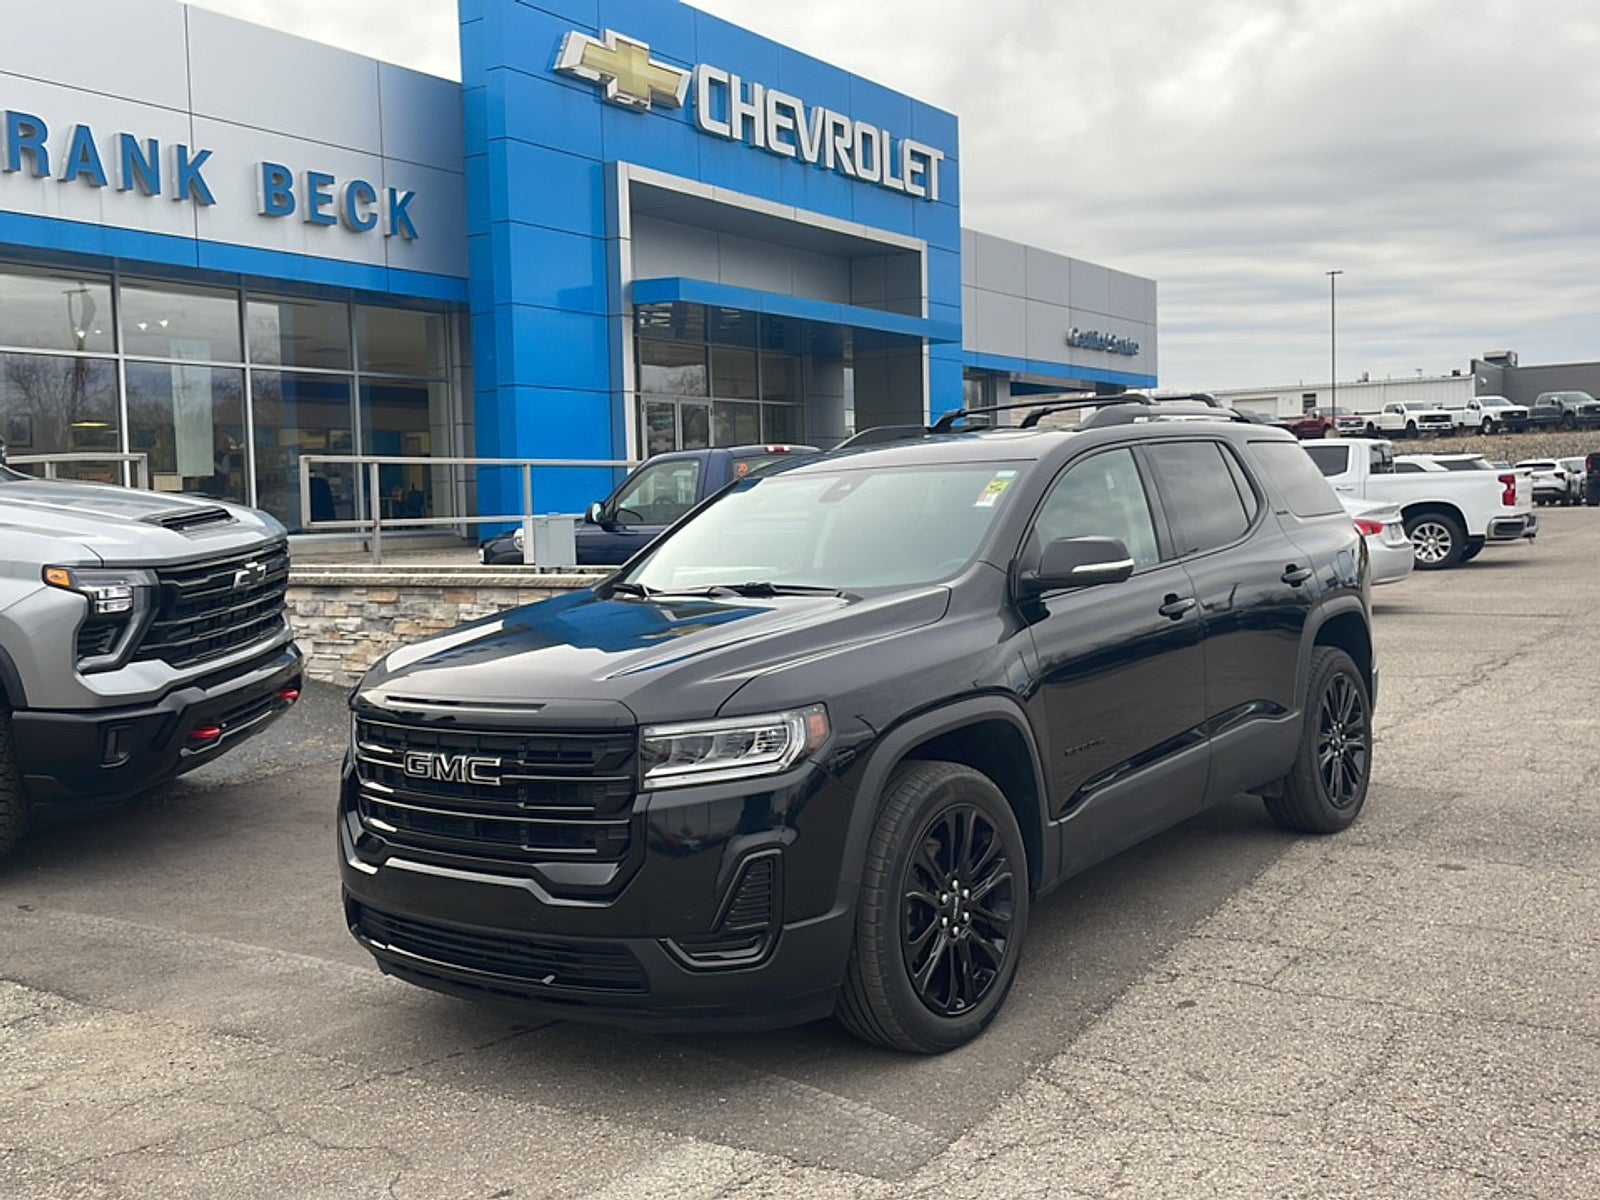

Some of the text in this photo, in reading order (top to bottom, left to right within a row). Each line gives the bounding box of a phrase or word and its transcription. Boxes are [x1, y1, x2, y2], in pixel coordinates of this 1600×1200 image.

[2, 109, 420, 241] RANK BECK
[693, 63, 945, 201] CHEVROLET
[403, 750, 502, 786] GMC
